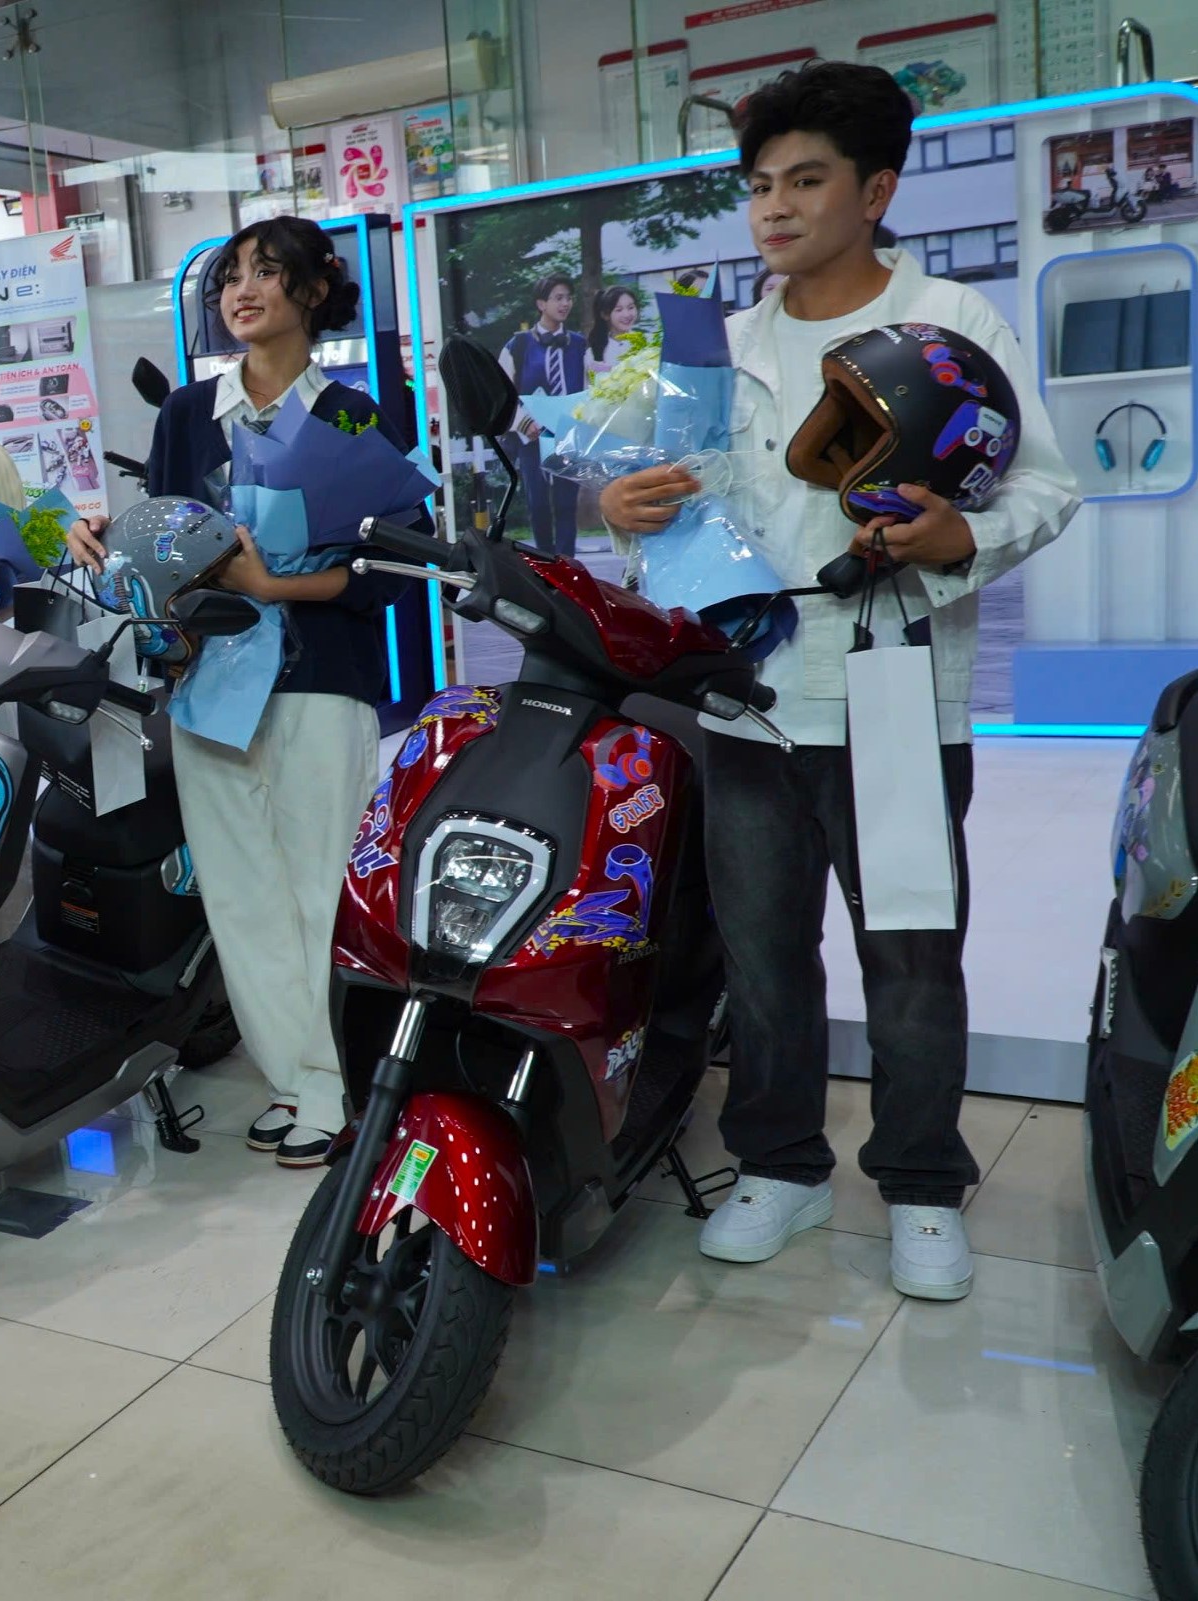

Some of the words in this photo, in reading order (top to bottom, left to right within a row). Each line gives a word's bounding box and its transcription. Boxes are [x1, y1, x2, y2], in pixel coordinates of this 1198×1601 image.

[521, 698, 574, 716] HONDA
[609, 783, 665, 834] START
[617, 945, 661, 966] HONDA
